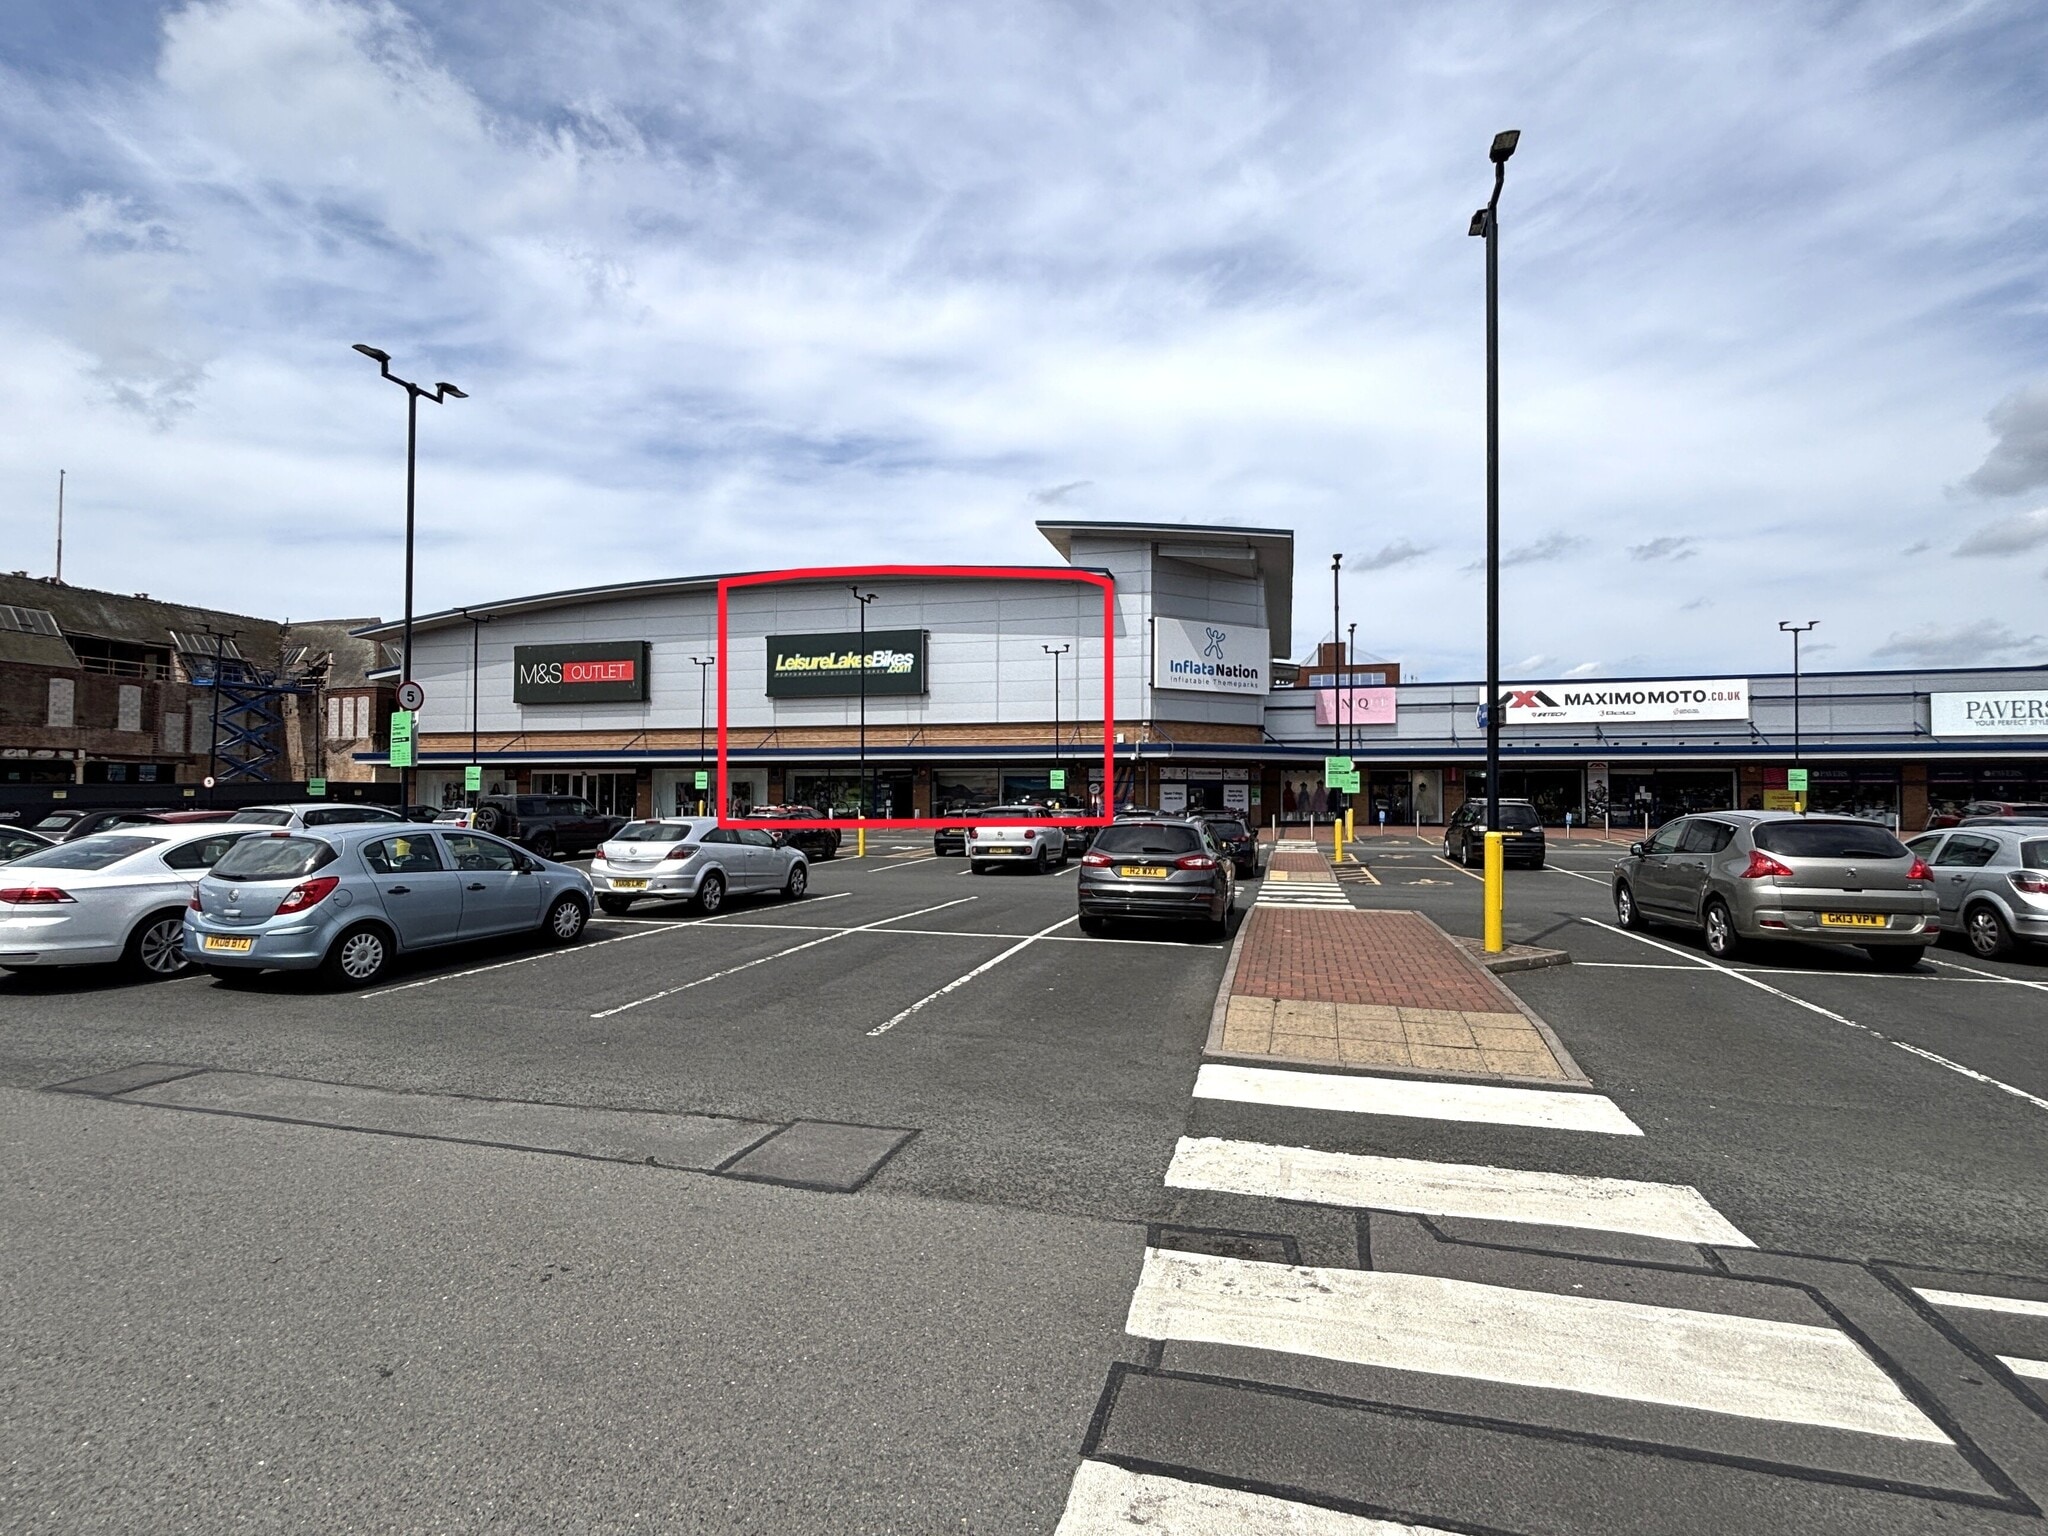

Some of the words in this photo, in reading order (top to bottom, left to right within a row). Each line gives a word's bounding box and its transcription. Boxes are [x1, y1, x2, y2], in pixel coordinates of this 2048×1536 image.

[520, 663, 562, 684] M&S
[571, 664, 626, 679] OUTLET
[1170, 660, 1258, 679] InflataNation
[1170, 676, 1210, 685] Inflatable
[1212, 679, 1258, 688] Themeparks
[406, 690, 415, 702] 5
[1828, 913, 1853, 923] GK13
[1856, 914, 1877, 924] VPW
